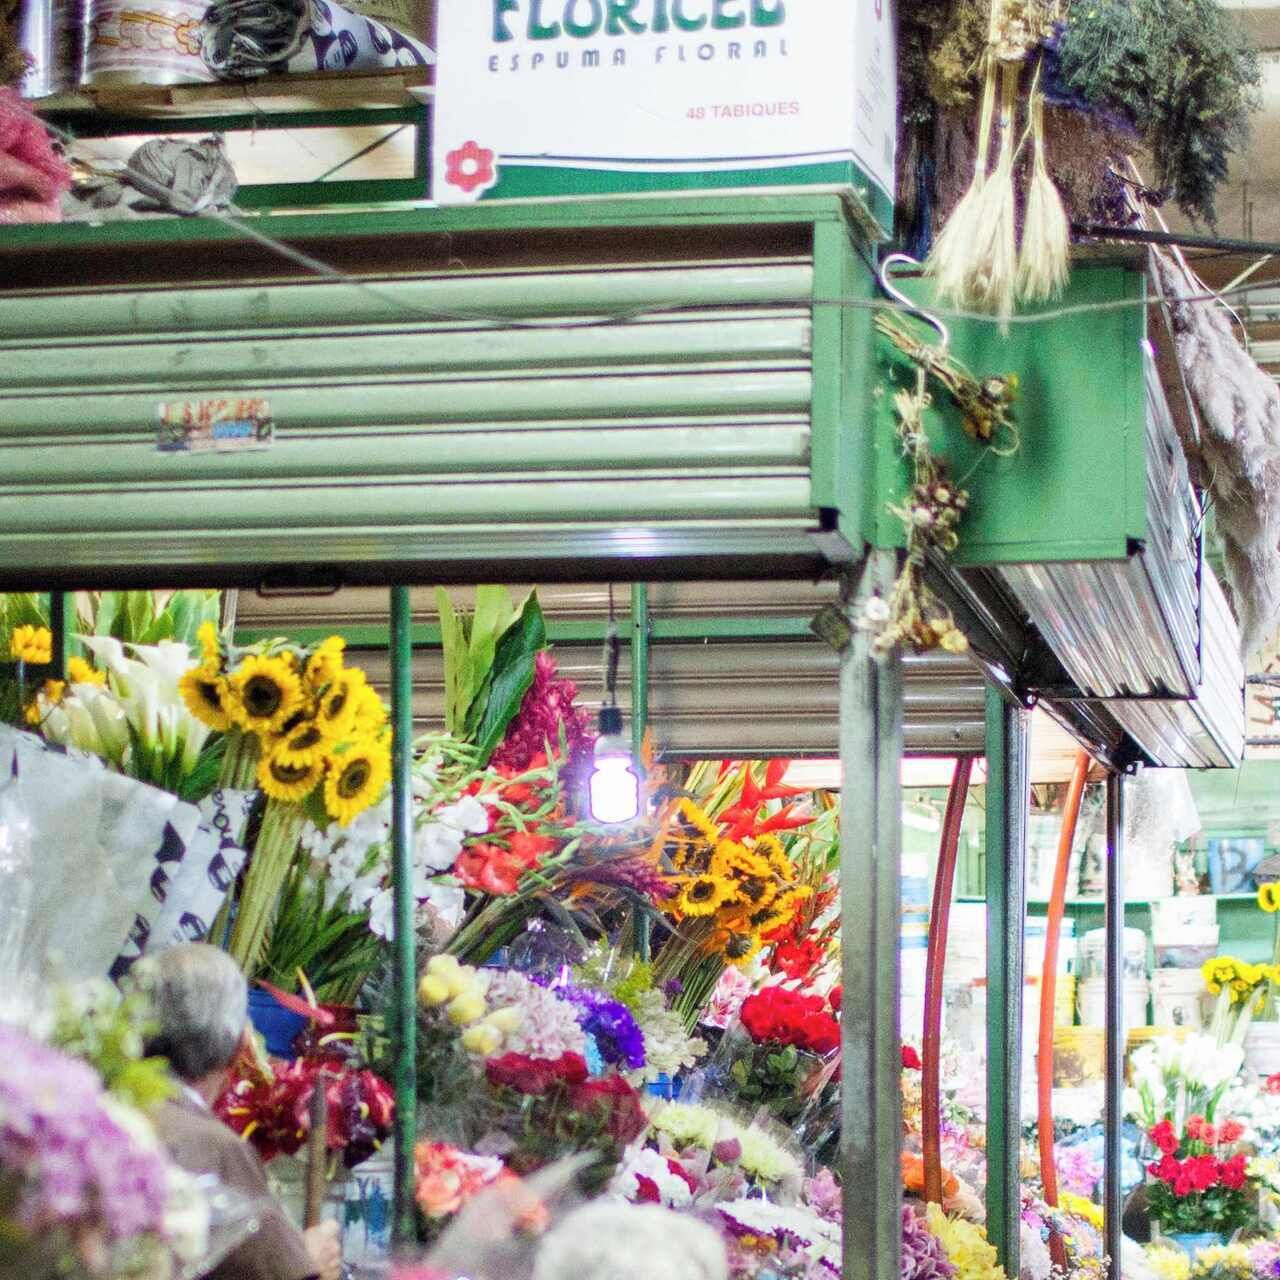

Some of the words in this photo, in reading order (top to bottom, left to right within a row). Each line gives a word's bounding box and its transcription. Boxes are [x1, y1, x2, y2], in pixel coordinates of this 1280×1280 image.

[488, 48, 626, 72] ESPUMA
[654, 39, 788, 64] FLORAL
[686, 106, 706, 119] 48
[711, 101, 800, 119] TABIQUES
